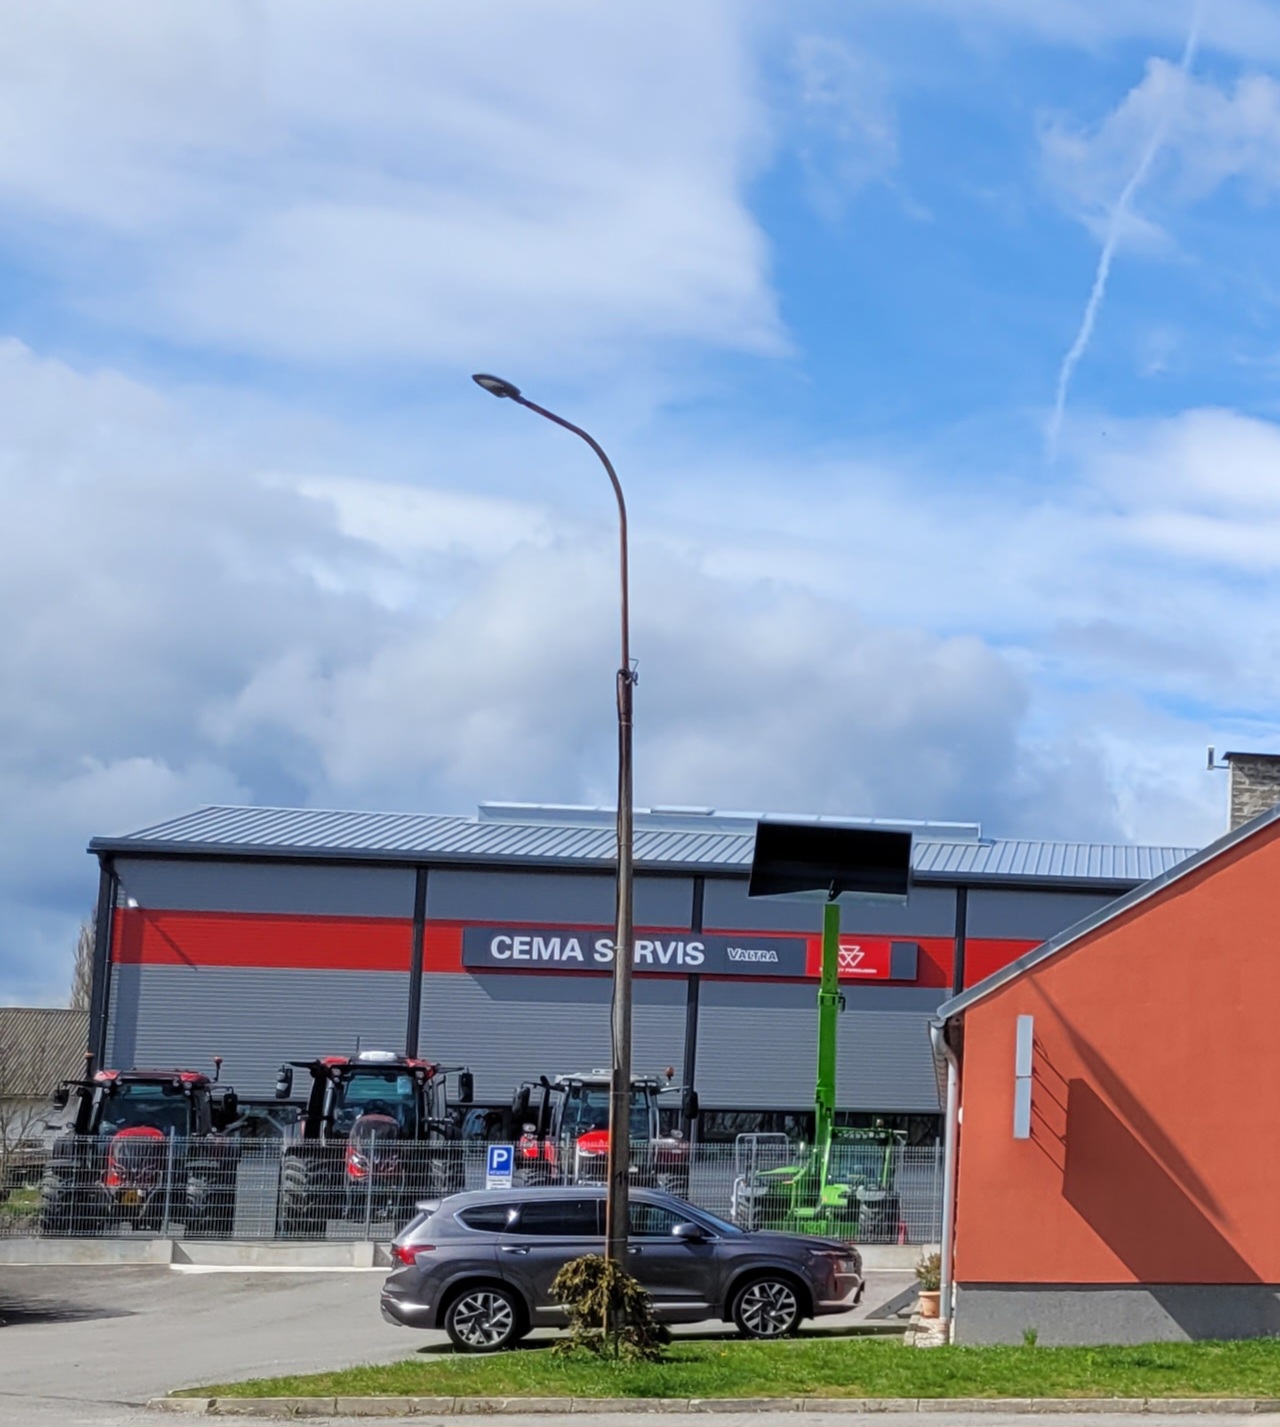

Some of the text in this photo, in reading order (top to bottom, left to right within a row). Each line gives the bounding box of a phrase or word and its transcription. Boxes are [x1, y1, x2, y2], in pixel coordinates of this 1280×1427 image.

[490, 935, 705, 965] CEMA SRVIS
[492, 1149, 508, 1169] P
